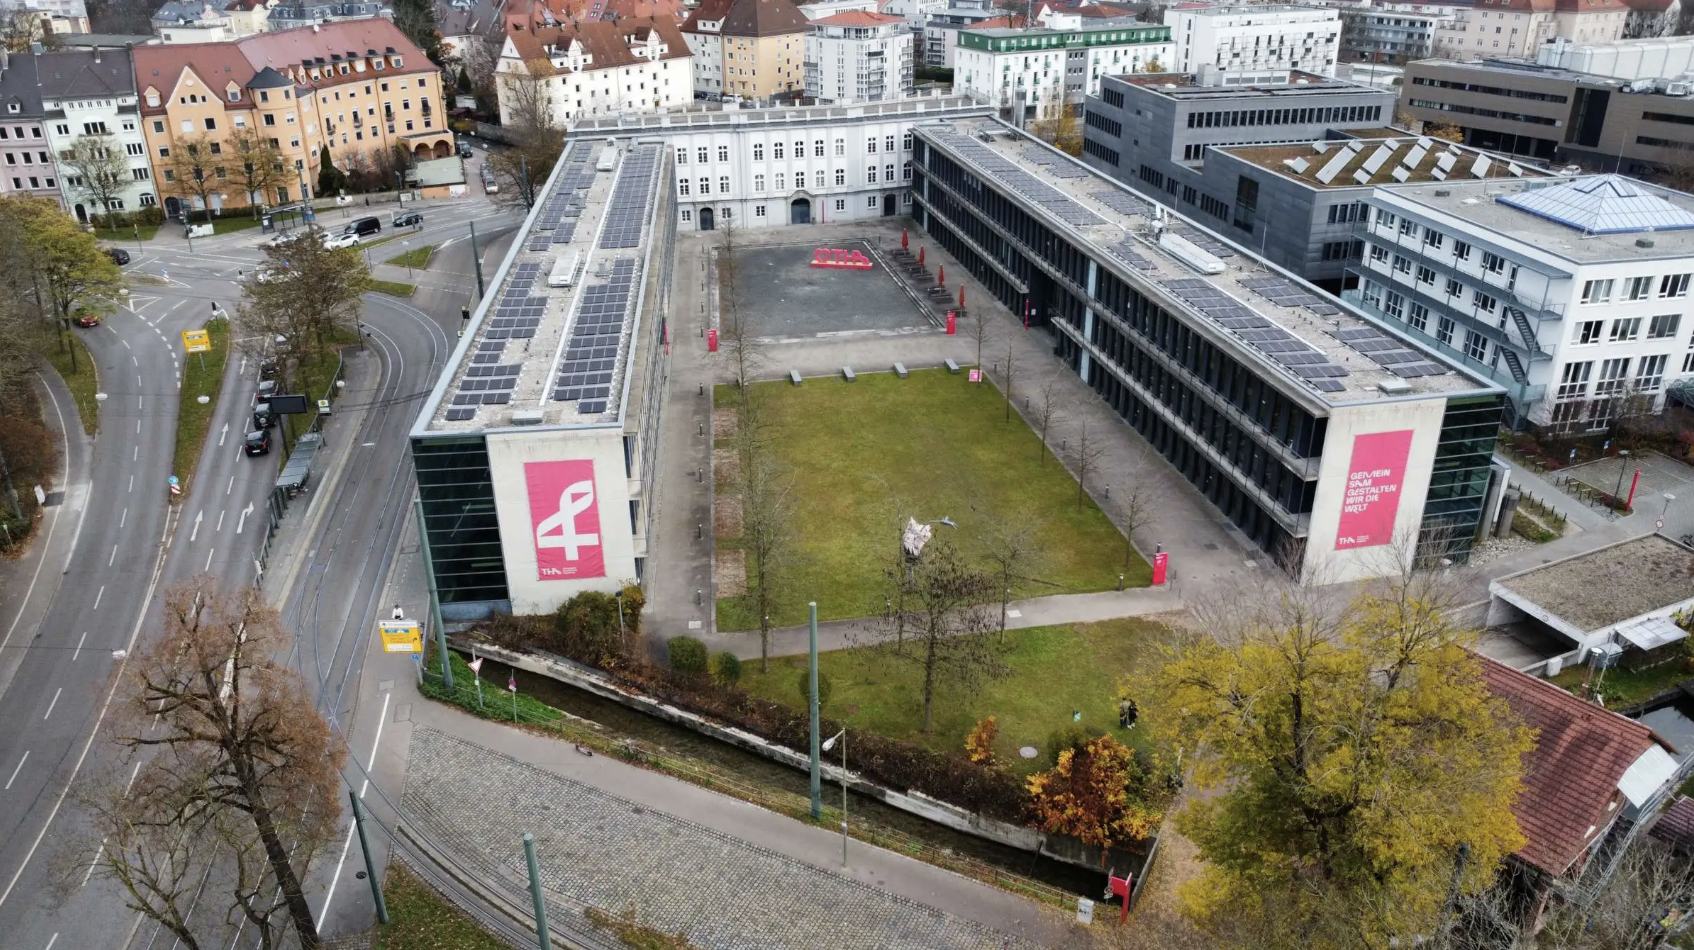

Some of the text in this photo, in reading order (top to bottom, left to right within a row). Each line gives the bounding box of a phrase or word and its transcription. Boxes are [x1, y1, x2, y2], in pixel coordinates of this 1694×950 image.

[1350, 468, 1391, 480] GEMEIN
[1349, 479, 1372, 488] SAM
[1347, 484, 1397, 496] GESTALTEN
[1346, 494, 1379, 505] WIR DIE
[1344, 503, 1368, 514] WELT
